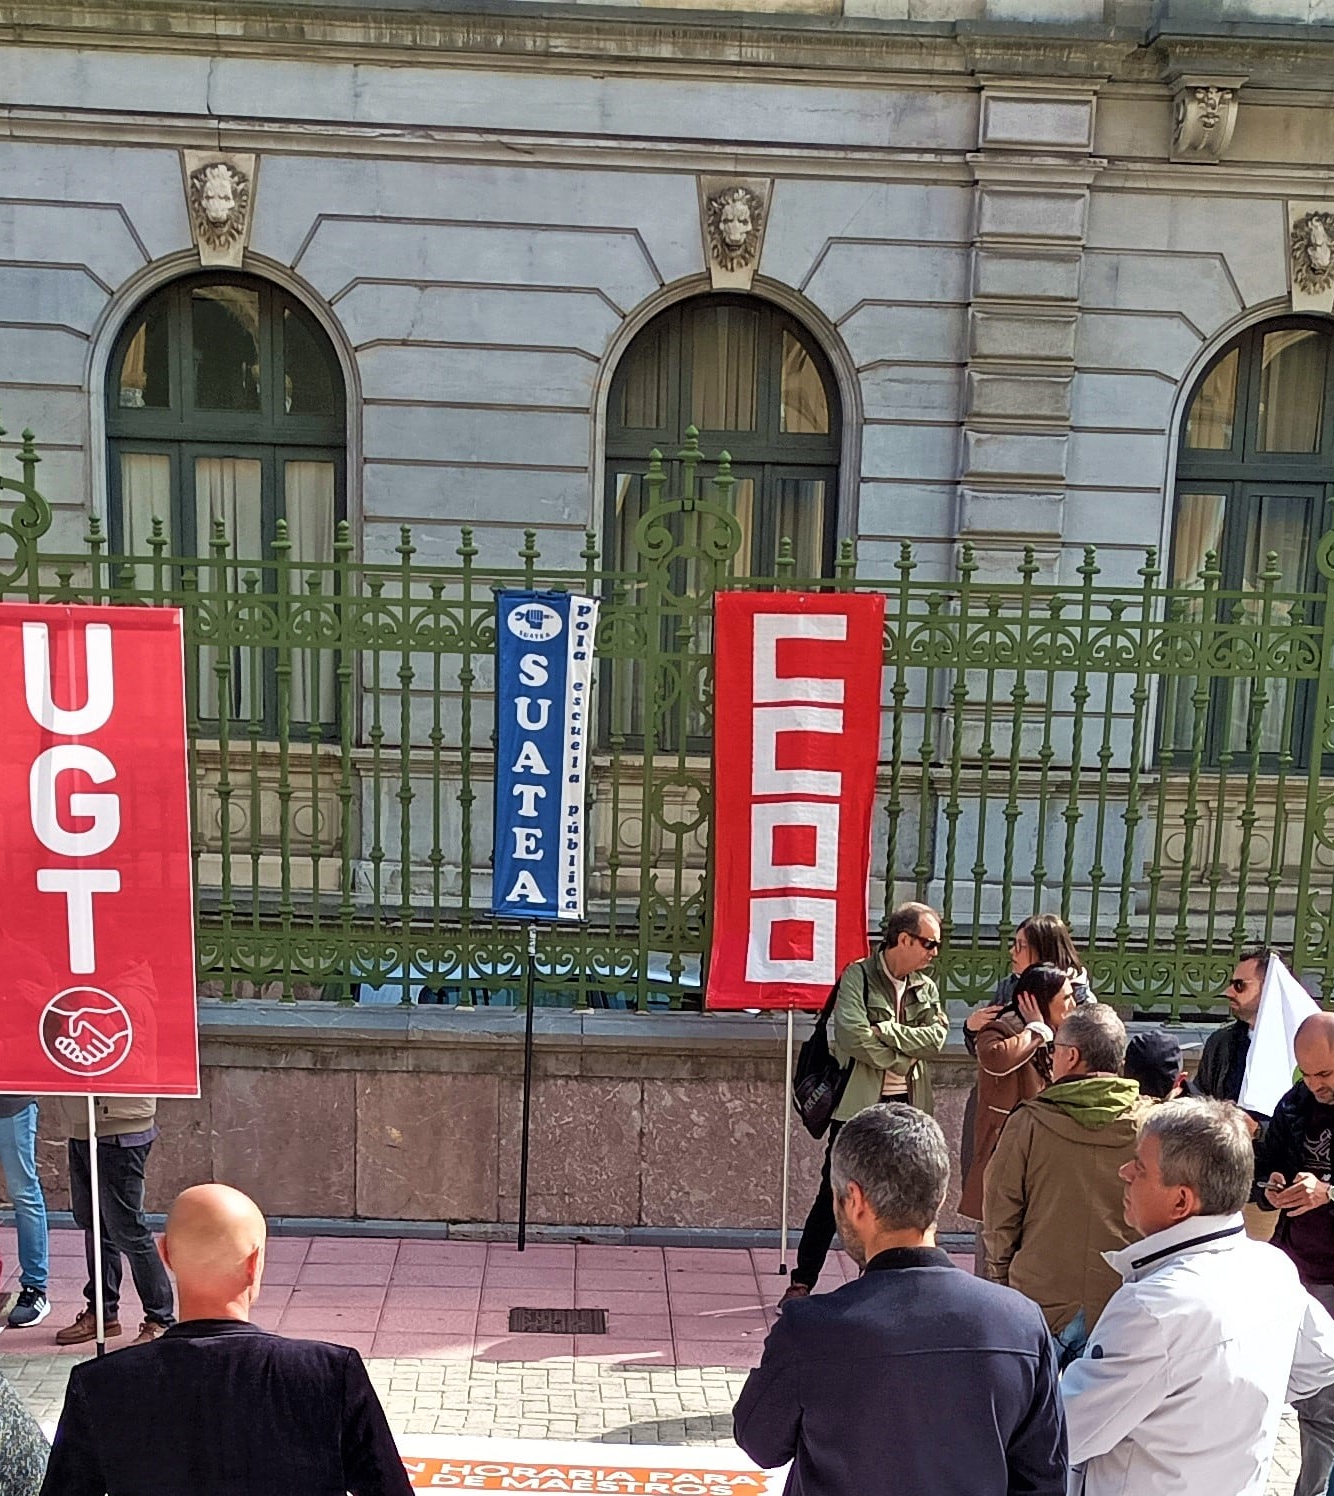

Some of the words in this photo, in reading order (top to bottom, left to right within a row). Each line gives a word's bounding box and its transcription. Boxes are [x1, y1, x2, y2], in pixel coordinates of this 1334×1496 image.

[573, 604, 591, 661] pola
[506, 654, 552, 904] SUATEA
[568, 681, 584, 783] escuela
[22, 621, 121, 974] UGT
[745, 613, 847, 985] CCOO
[565, 804, 579, 910] pública
[431, 1474, 485, 1487] DE
[440, 1464, 637, 1483] HORARIA
[649, 1472, 759, 1487] PARA
